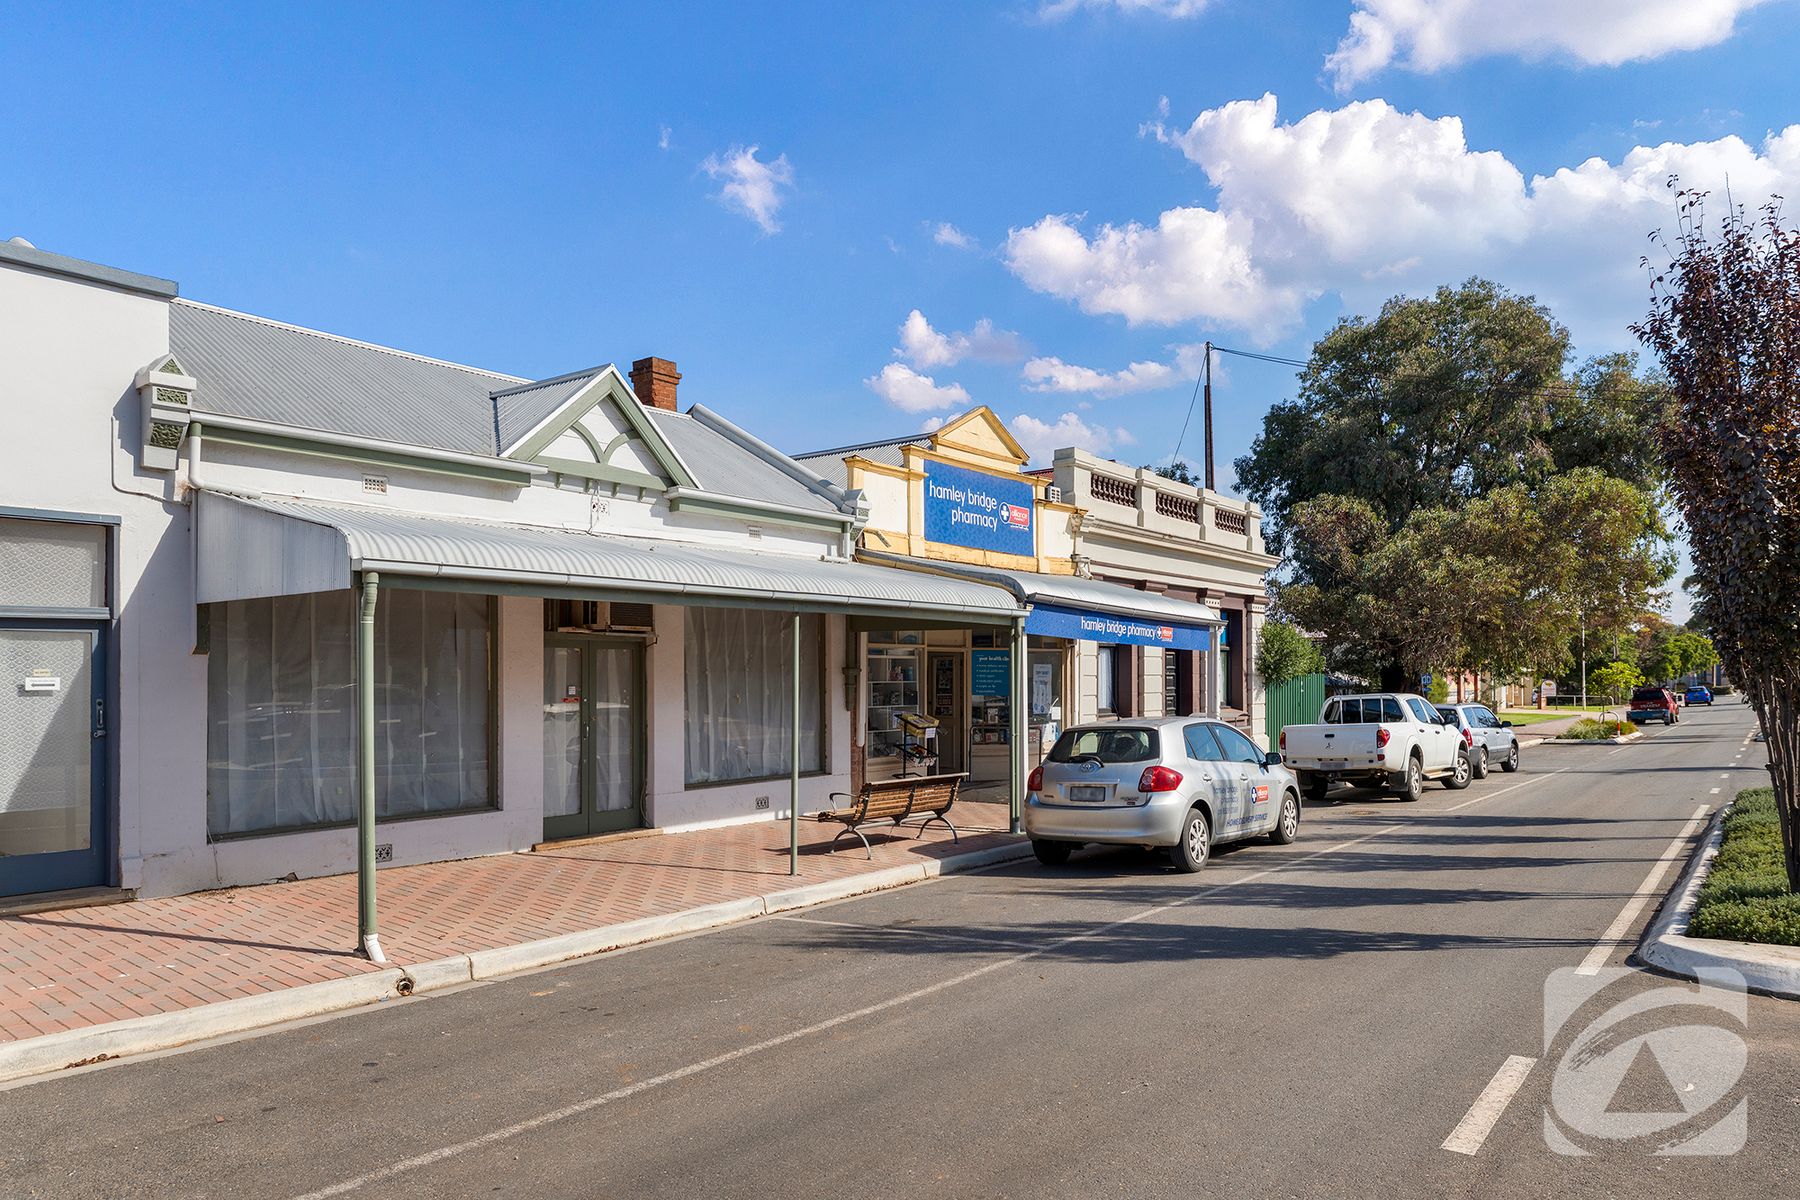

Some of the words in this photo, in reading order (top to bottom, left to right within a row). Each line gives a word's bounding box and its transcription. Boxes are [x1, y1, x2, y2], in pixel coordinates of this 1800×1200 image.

[929, 479, 966, 507] hamley
[968, 488, 998, 513] bridge
[951, 506, 998, 533] pharmacy
[1081, 616, 1106, 634] hamley
[1106, 620, 1127, 636] bridge
[1127, 623, 1156, 640] pharmacy
